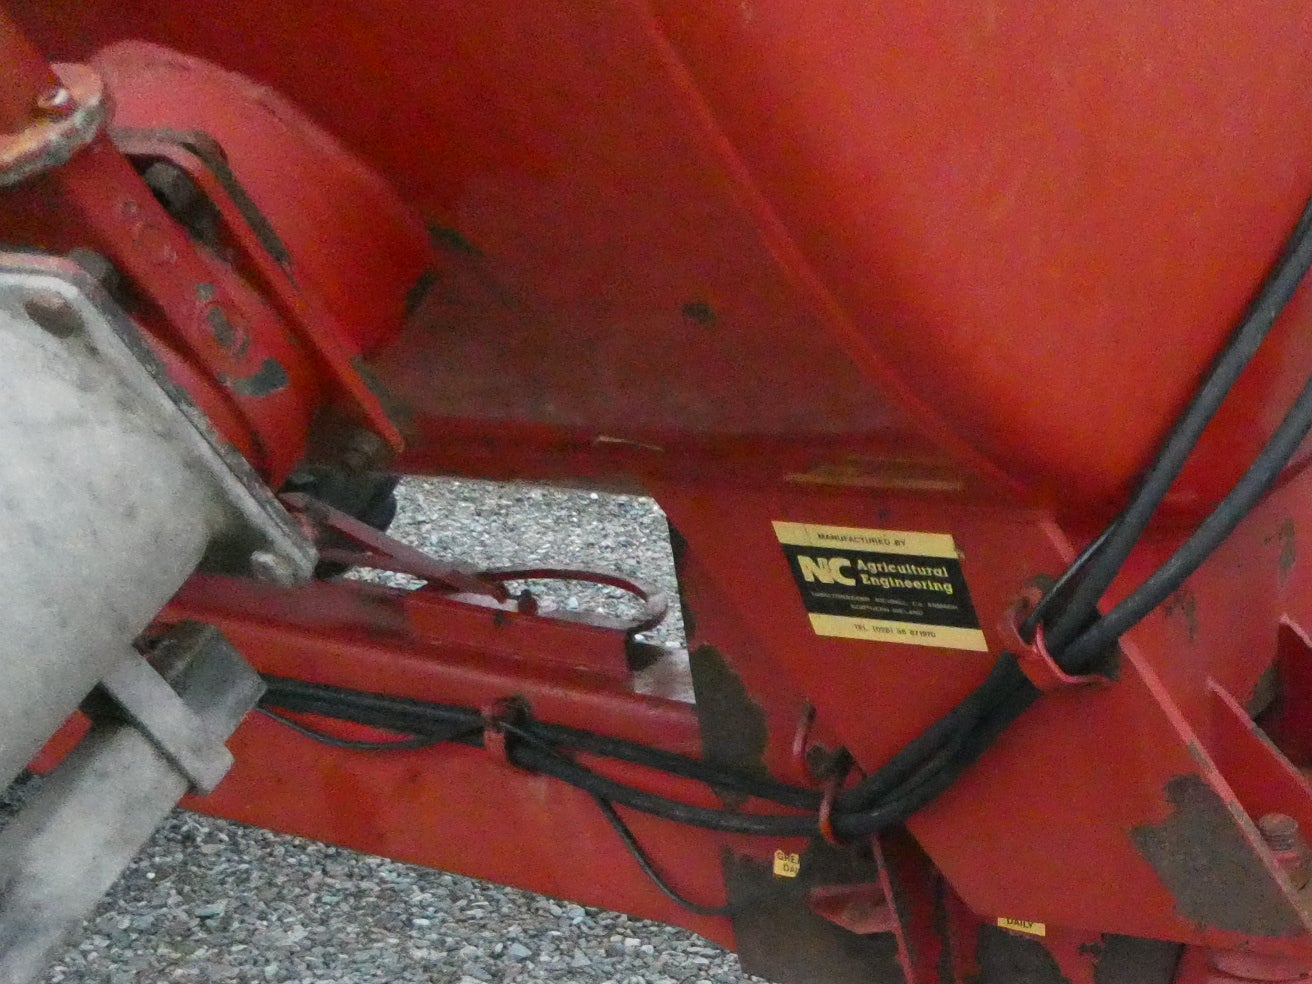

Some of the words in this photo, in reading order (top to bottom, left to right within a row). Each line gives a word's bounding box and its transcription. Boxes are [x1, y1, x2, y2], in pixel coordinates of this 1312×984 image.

[817, 532, 891, 547] MANUFACTURED
[893, 538, 906, 547] BY
[797, 555, 857, 587] NC
[857, 559, 948, 578] Agricultural
[859, 573, 954, 595] Engineering
